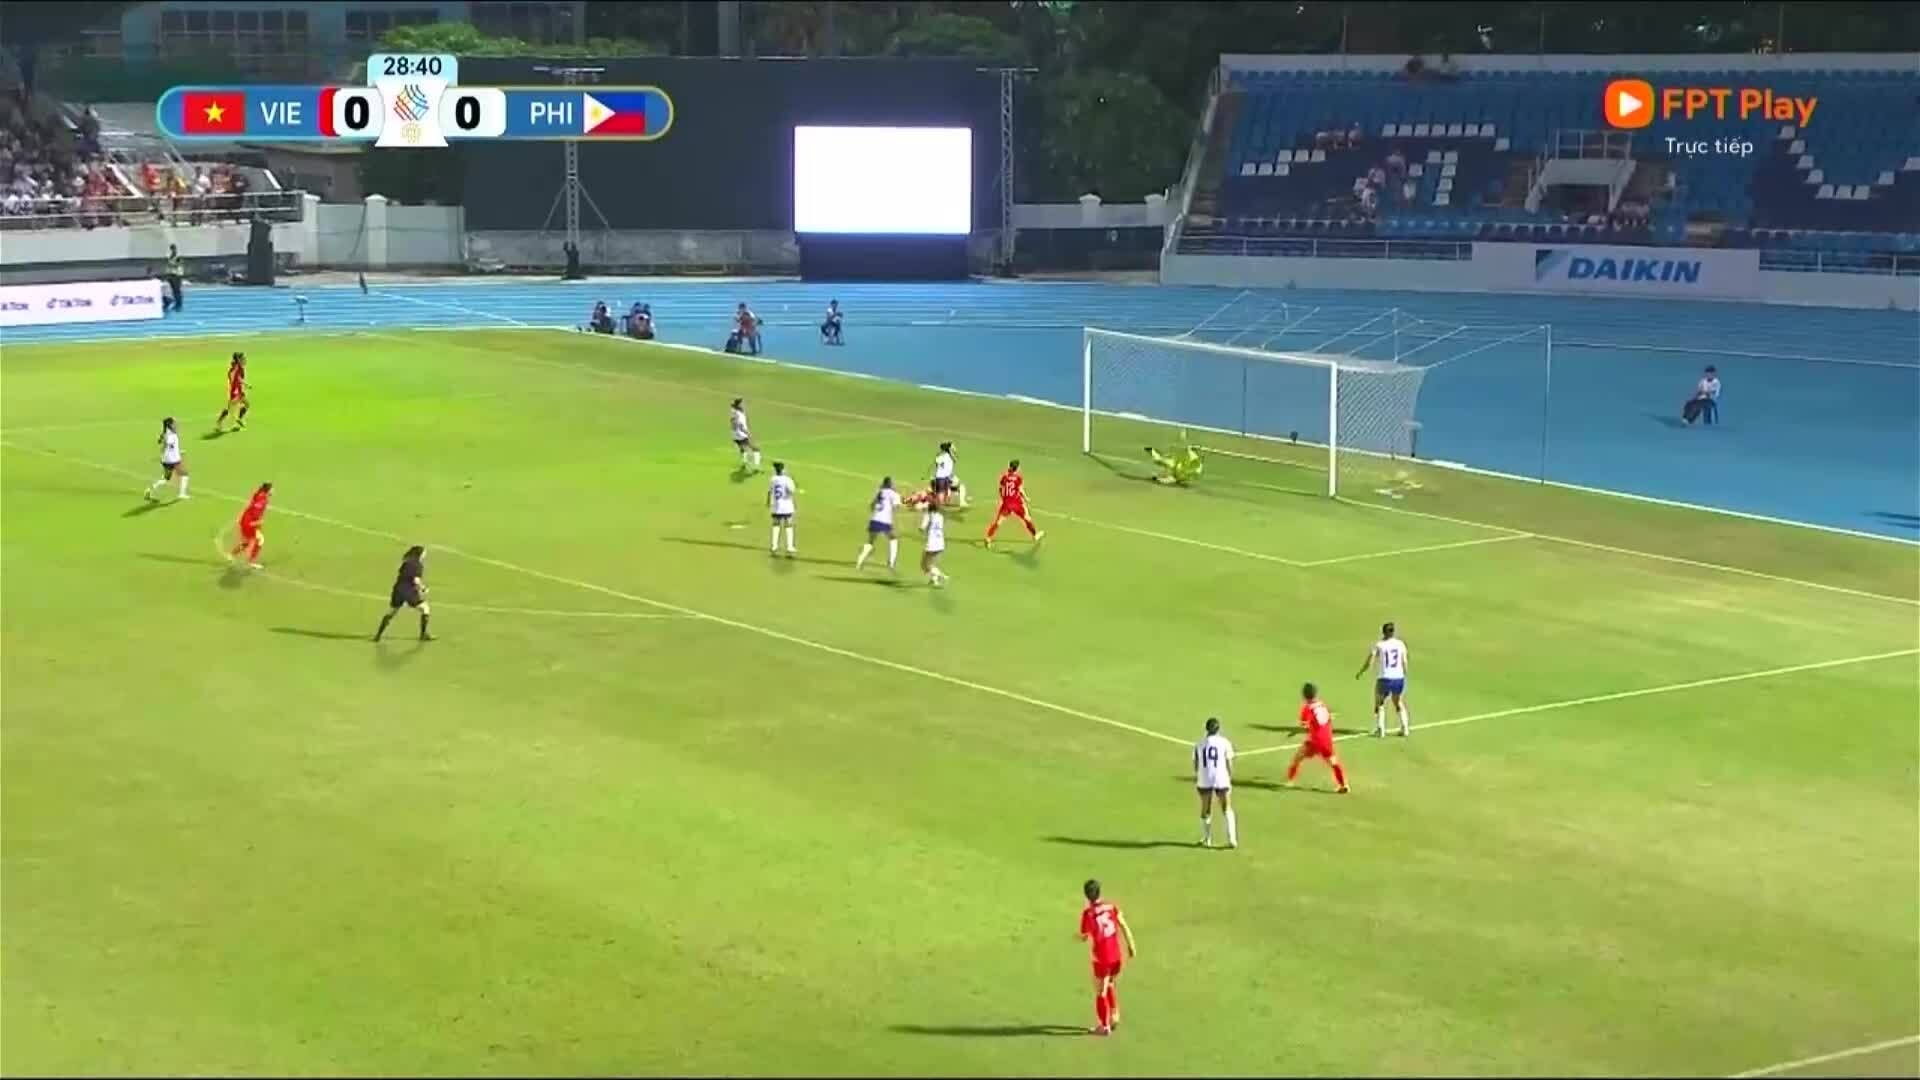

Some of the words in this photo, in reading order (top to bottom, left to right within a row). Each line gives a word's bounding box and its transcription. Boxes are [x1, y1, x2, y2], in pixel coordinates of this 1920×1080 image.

[1568, 257, 1702, 283] DAIKIN
[1384, 649, 1399, 668] 13
[1202, 746, 1218, 768] 19
